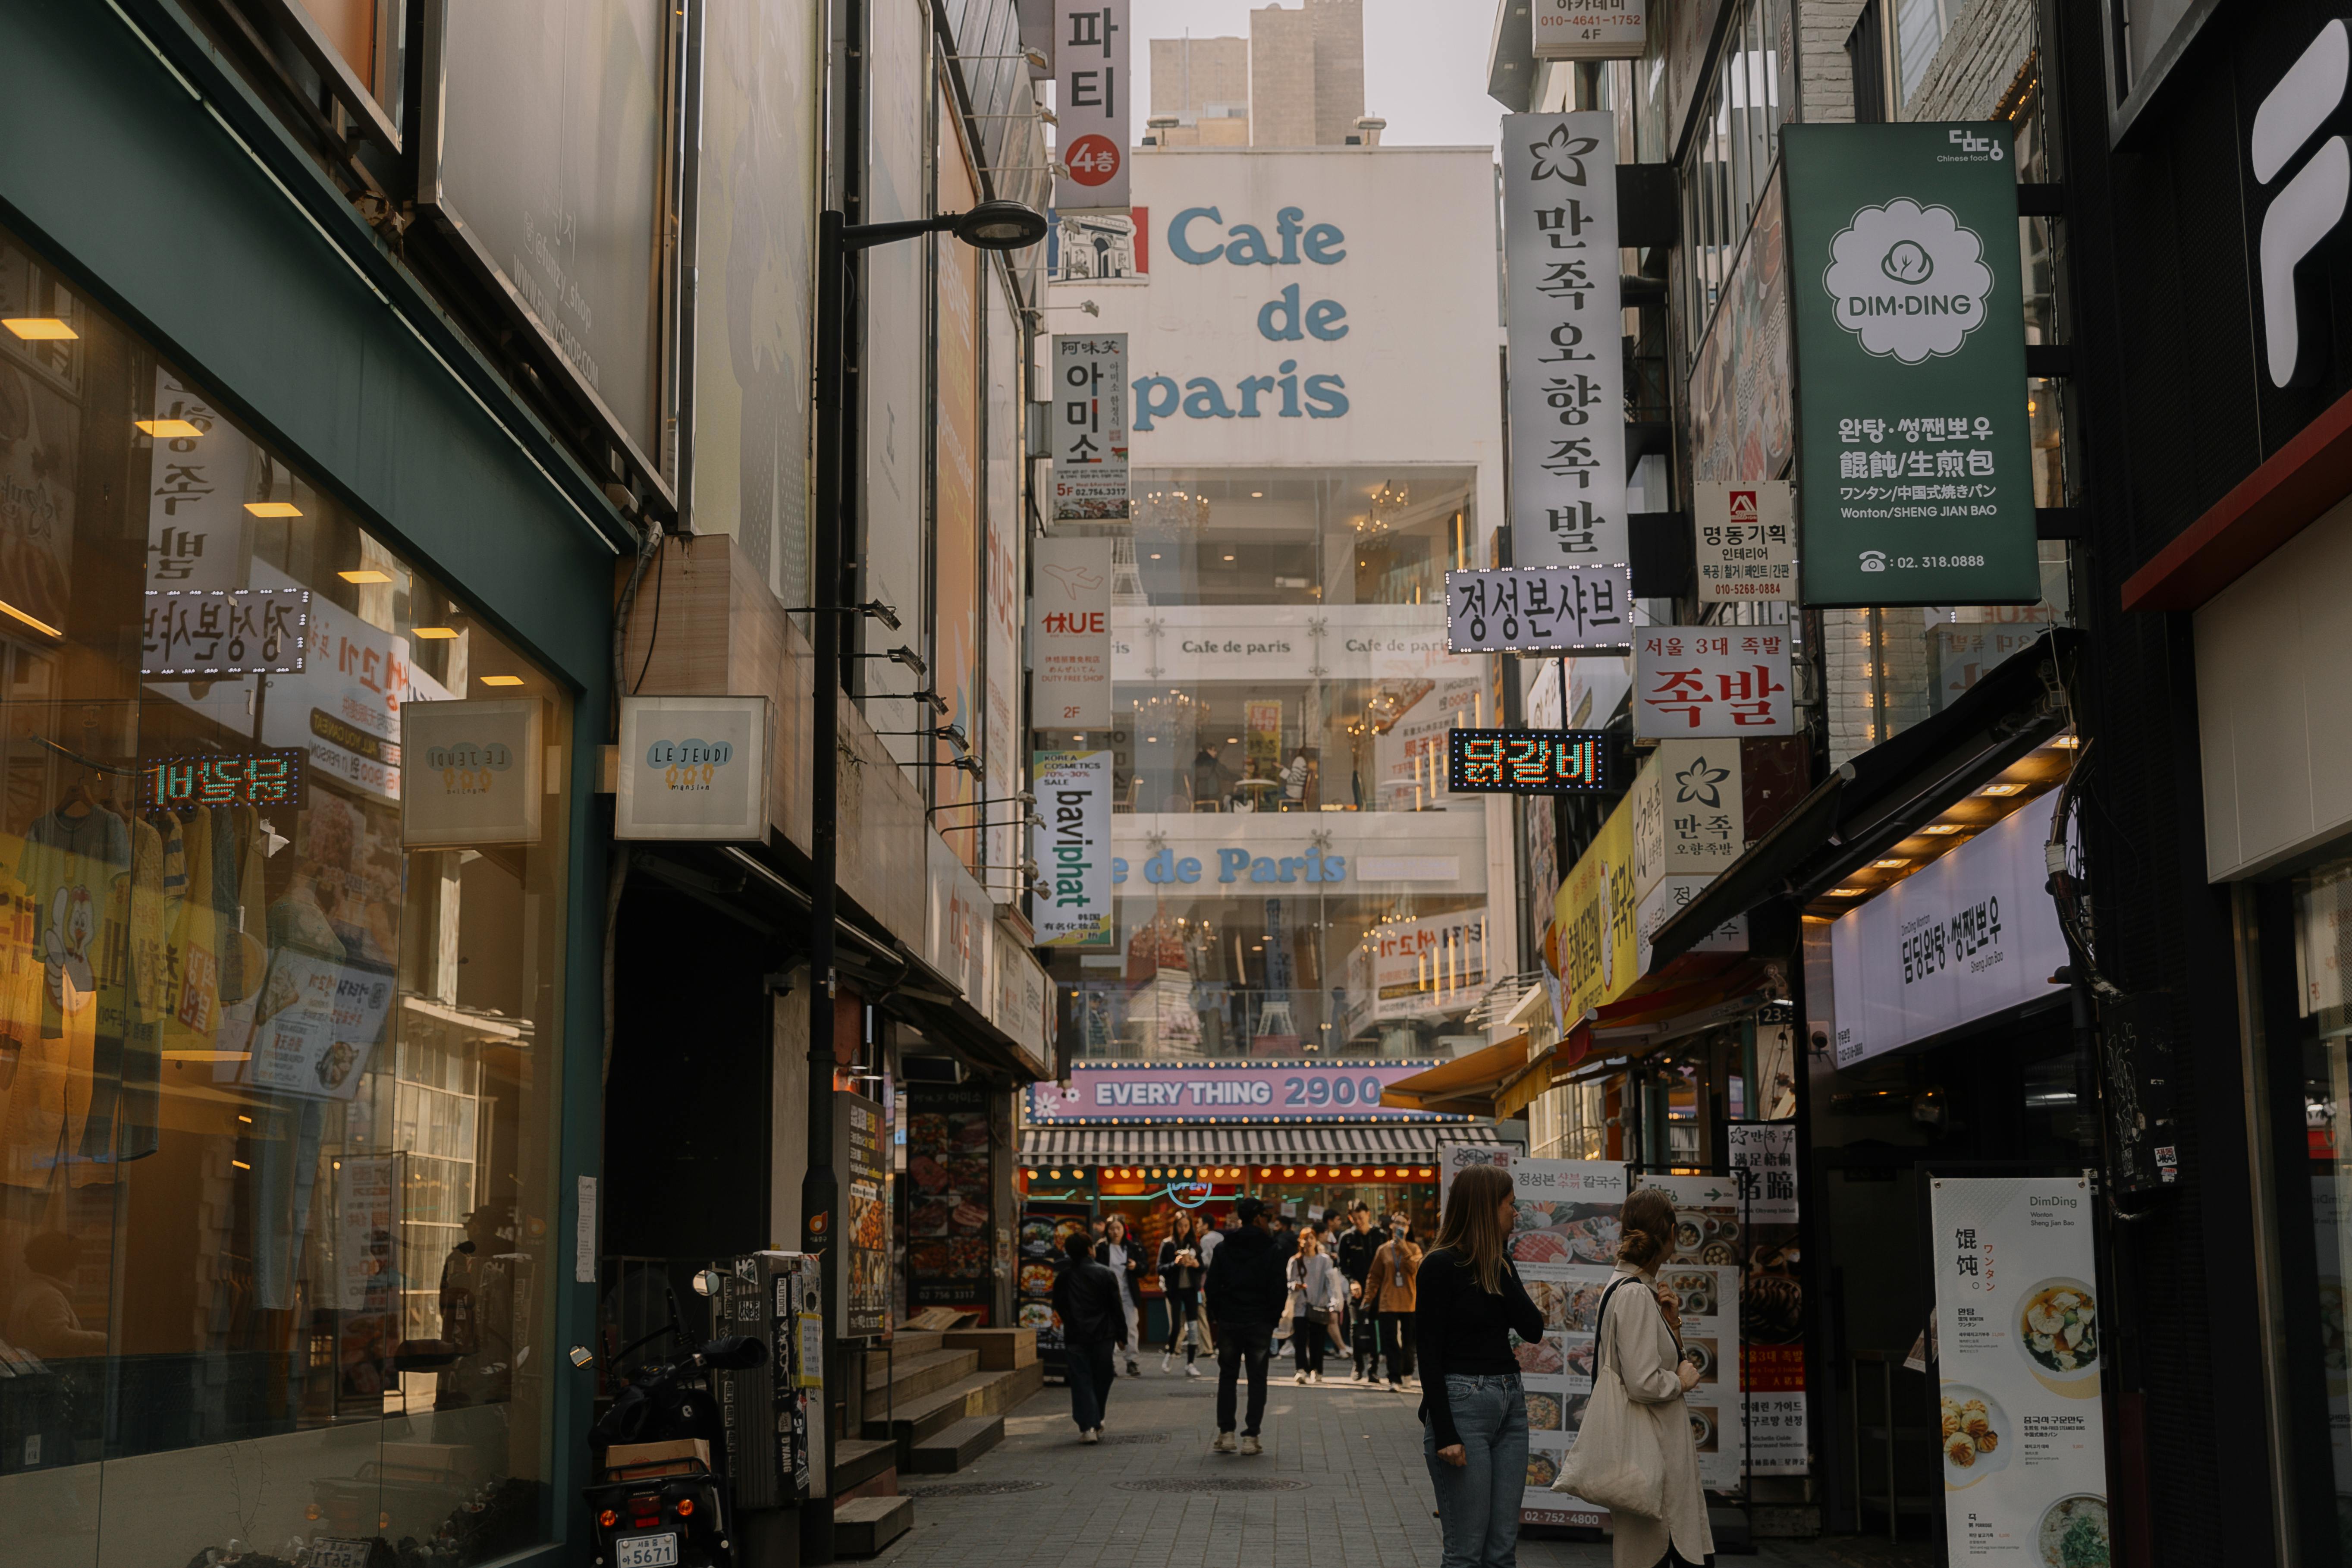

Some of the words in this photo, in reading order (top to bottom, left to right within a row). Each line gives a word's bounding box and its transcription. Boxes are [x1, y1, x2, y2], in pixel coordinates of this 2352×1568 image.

[1541, 15, 1640, 26] 010-4641-1752
[1581, 28, 1601, 40] 4F
[1068, 7, 1118, 118] 파티
[1071, 144, 1114, 172] 4층
[1168, 206, 1347, 265] Cafe
[1258, 283, 1349, 341] de
[1533, 199, 1605, 553] 만족오향족발
[1131, 359, 1350, 431] paris
[1066, 362, 1104, 463] 아미소
[1057, 483, 1074, 496] 5F
[1840, 506, 1937, 518] Wonton/SHENG
[1940, 506, 1968, 516] JIAN
[1971, 505, 1997, 516] BAO
[1704, 525, 1787, 546] 명동기획
[1722, 547, 1768, 561] 인테리어
[1715, 584, 1780, 595] 010-5268-0884
[1459, 575, 1620, 641] 정성본샤브
[1182, 641, 1220, 654] Cafe
[1223, 641, 1242, 654] de
[1248, 641, 1291, 656] paris
[1345, 639, 1382, 652] Cafe
[1386, 639, 1405, 652] de
[1645, 638, 1684, 657] 서울
[1696, 637, 1728, 656] 3대
[1740, 636, 1782, 655] 족발
[1644, 665, 1785, 728] 족발
[1064, 706, 1080, 718] 2F
[655, 748, 673, 763] LE
[681, 747, 729, 763] JEUDI
[1464, 738, 1595, 784] 닭갈비
[671, 783, 710, 792] mansion
[1673, 814, 1733, 840] 만족
[1052, 790, 1093, 908] baviphat
[1674, 842, 1733, 856] 오향족발
[1143, 848, 1202, 884] de
[1217, 847, 1346, 884] Paris
[1095, 1081, 1182, 1106] EVERY
[1188, 1081, 1272, 1106] THING
[1750, 1129, 1777, 1143] 만족
[1518, 1172, 1556, 1187] 정성본
[1583, 1175, 1622, 1190] 칼국수
[2030, 1196, 2077, 1208] DimDing
[1984, 1244, 1995, 1291] ワンタン
[1774, 1401, 1802, 1412] 가이드
[622, 1555, 631, 1565] 아
[634, 1546, 670, 1564] 5671
